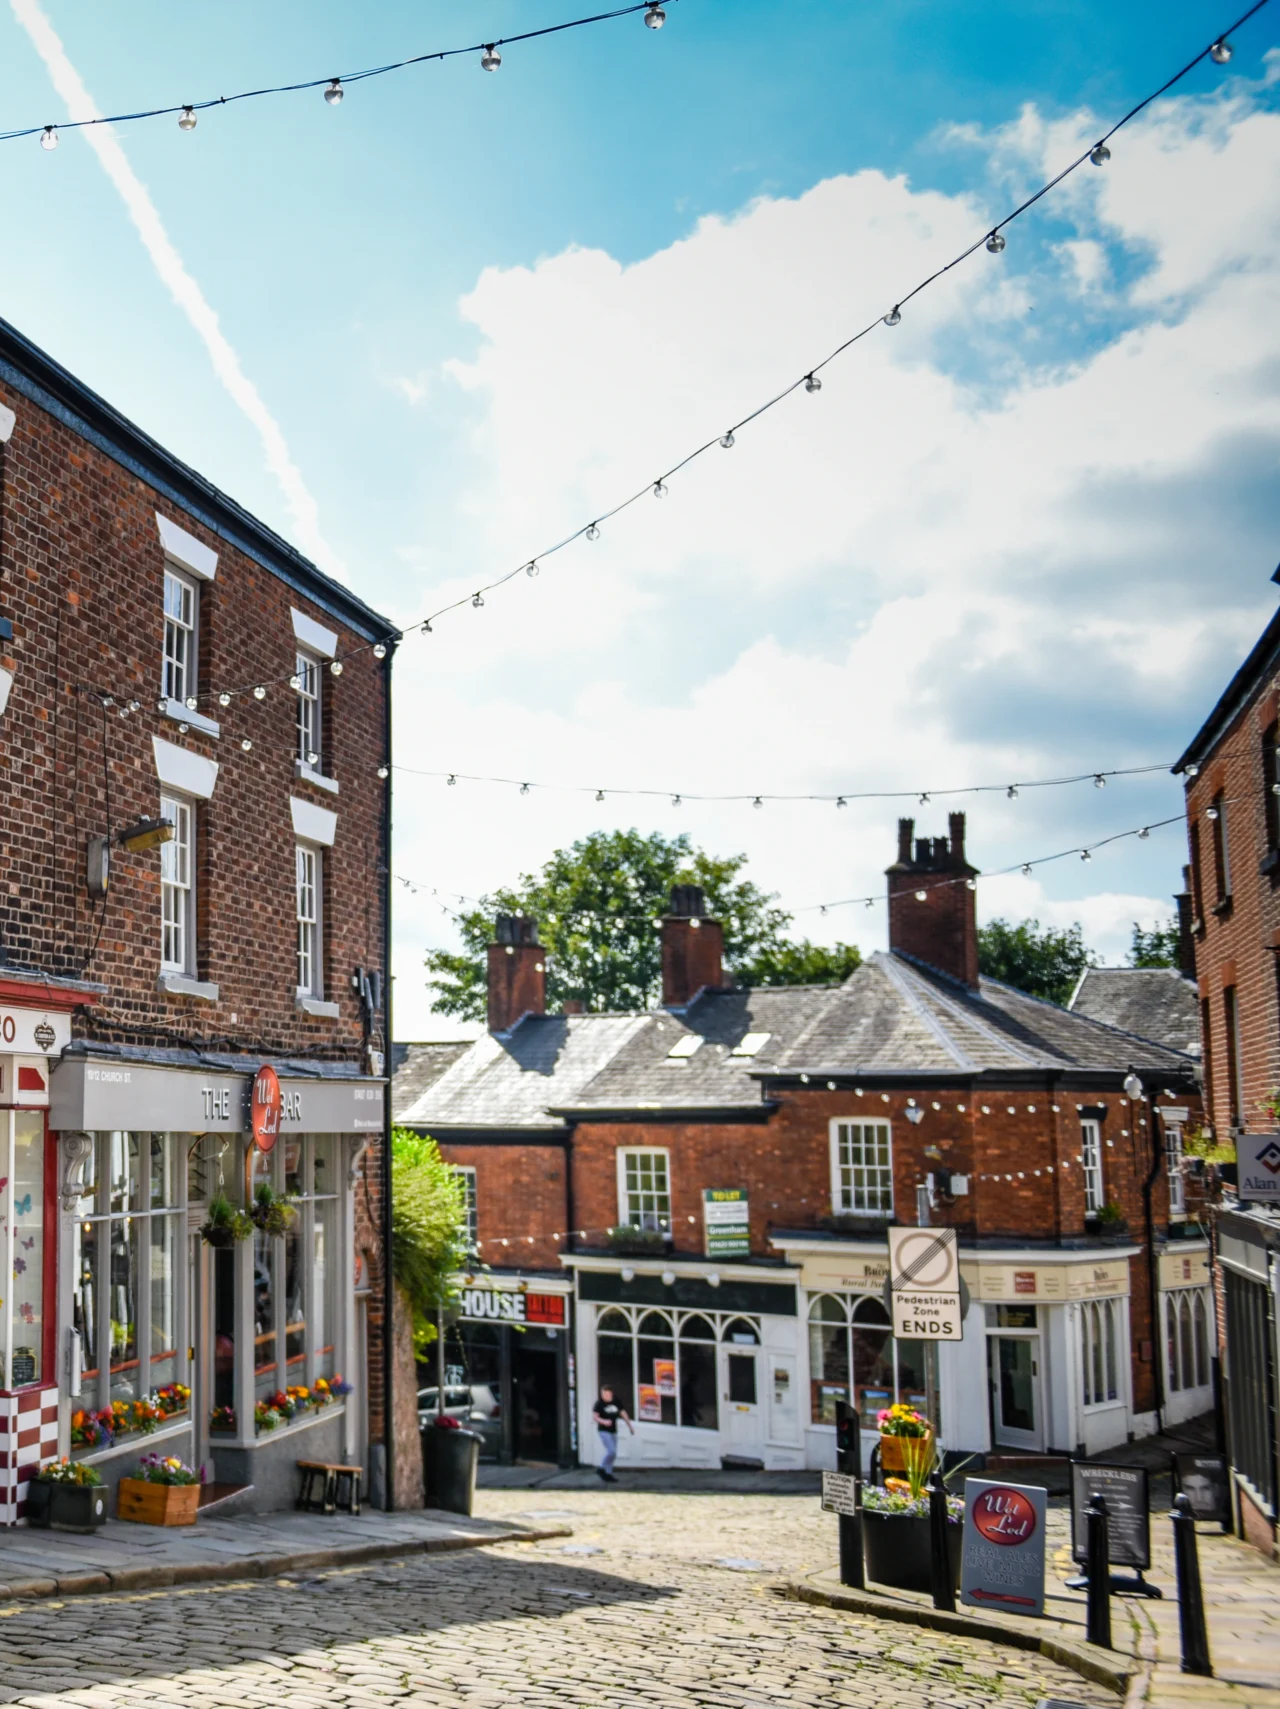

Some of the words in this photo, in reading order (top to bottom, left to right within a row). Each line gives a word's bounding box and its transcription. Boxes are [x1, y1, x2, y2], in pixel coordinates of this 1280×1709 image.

[101, 1070, 123, 1082] CHURCH
[256, 1078, 274, 1105] Wet
[202, 1087, 230, 1120] THE
[258, 1106, 277, 1136] Led
[1243, 1175, 1278, 1190] Alan
[709, 1226, 749, 1236] Greenham
[460, 1289, 526, 1321] HOUSE
[896, 1294, 957, 1306] Pedestrian
[913, 1306, 940, 1317] Zone
[902, 1320, 954, 1335] ENDS
[825, 1473, 852, 1484] CAUTION
[1081, 1468, 1138, 1482] WRECKLESS
[984, 1494, 1021, 1516] Wet
[985, 1514, 1028, 1537] Led
[968, 1543, 1001, 1560] REAL
[1006, 1549, 1039, 1564] ALES
[965, 1556, 995, 1570] LIVE
[998, 1560, 1041, 1578] MUSIC
[983, 1571, 1025, 1588] WINES
